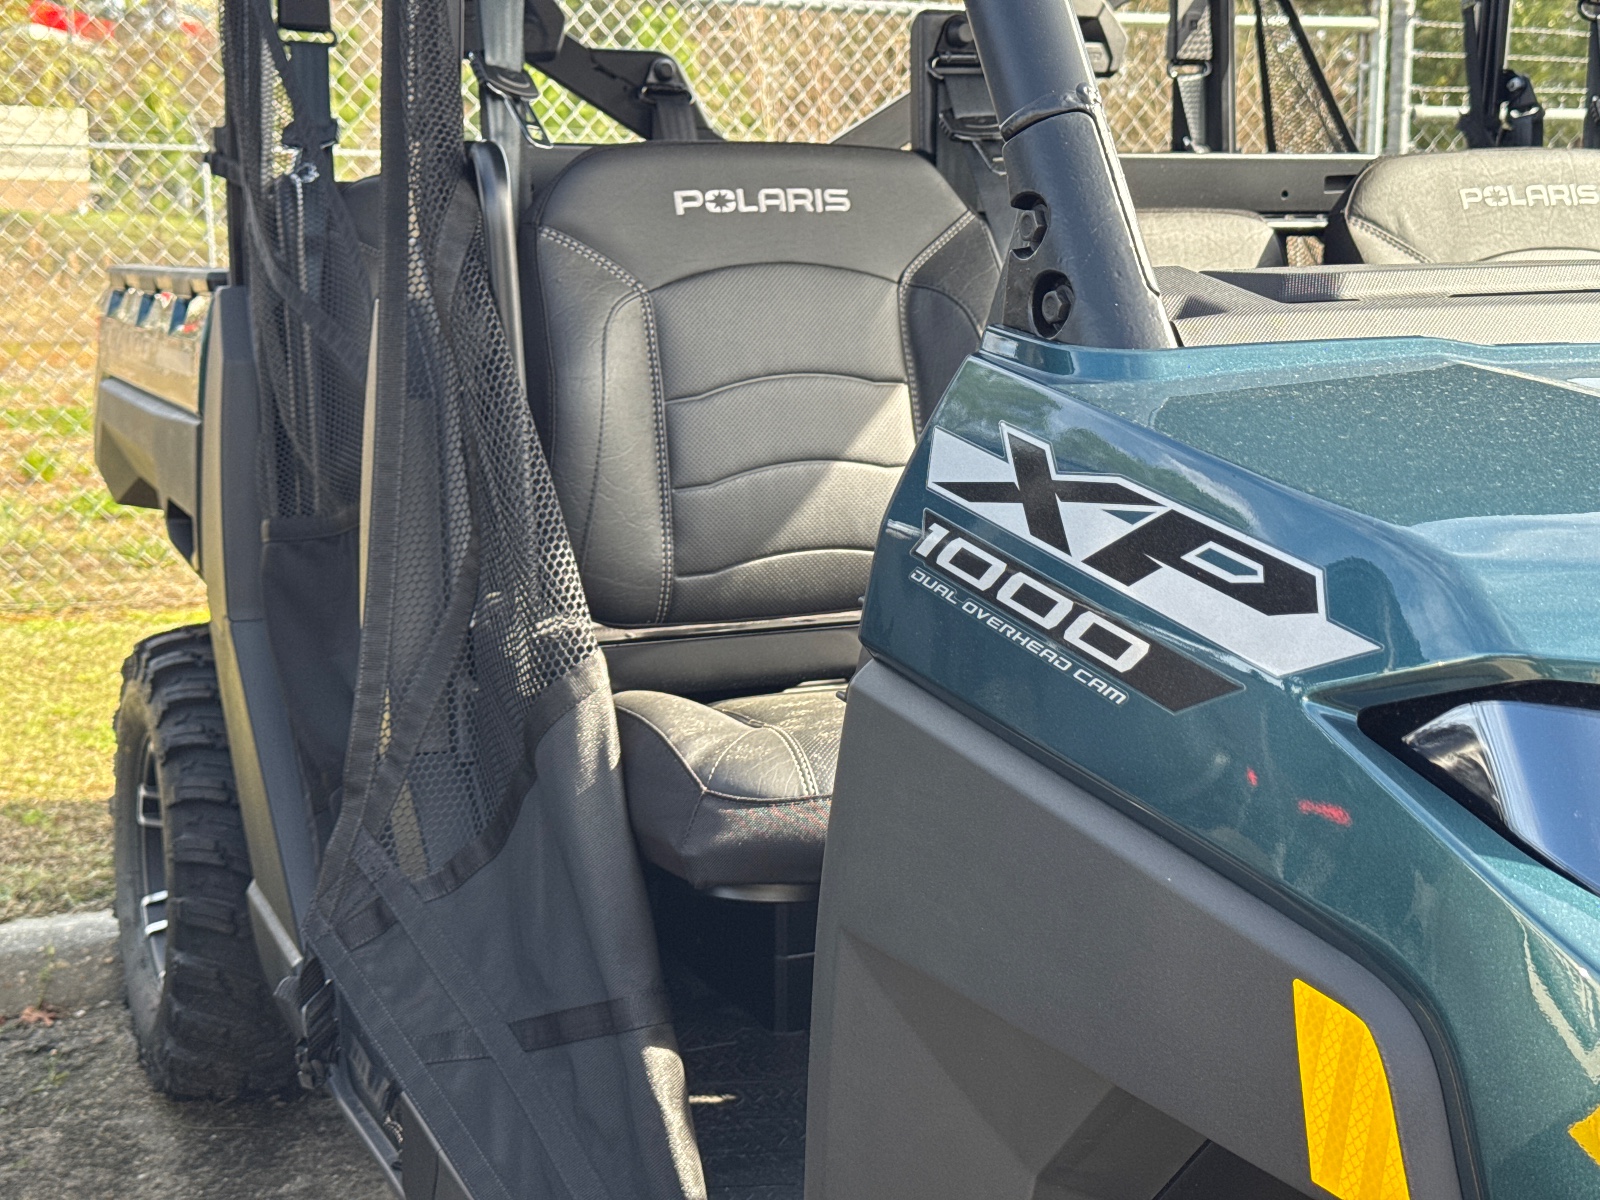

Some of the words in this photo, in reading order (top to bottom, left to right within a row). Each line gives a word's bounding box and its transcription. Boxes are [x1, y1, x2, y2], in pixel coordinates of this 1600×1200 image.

[673, 188, 850, 215] POLARIS
[1459, 184, 1600, 210] POLARIS
[929, 423, 1327, 621] XP
[911, 568, 958, 605] DUAL
[961, 597, 1072, 672] OVERHEAD
[1072, 667, 1128, 705] CAM
[915, 522, 1151, 673] 1000
